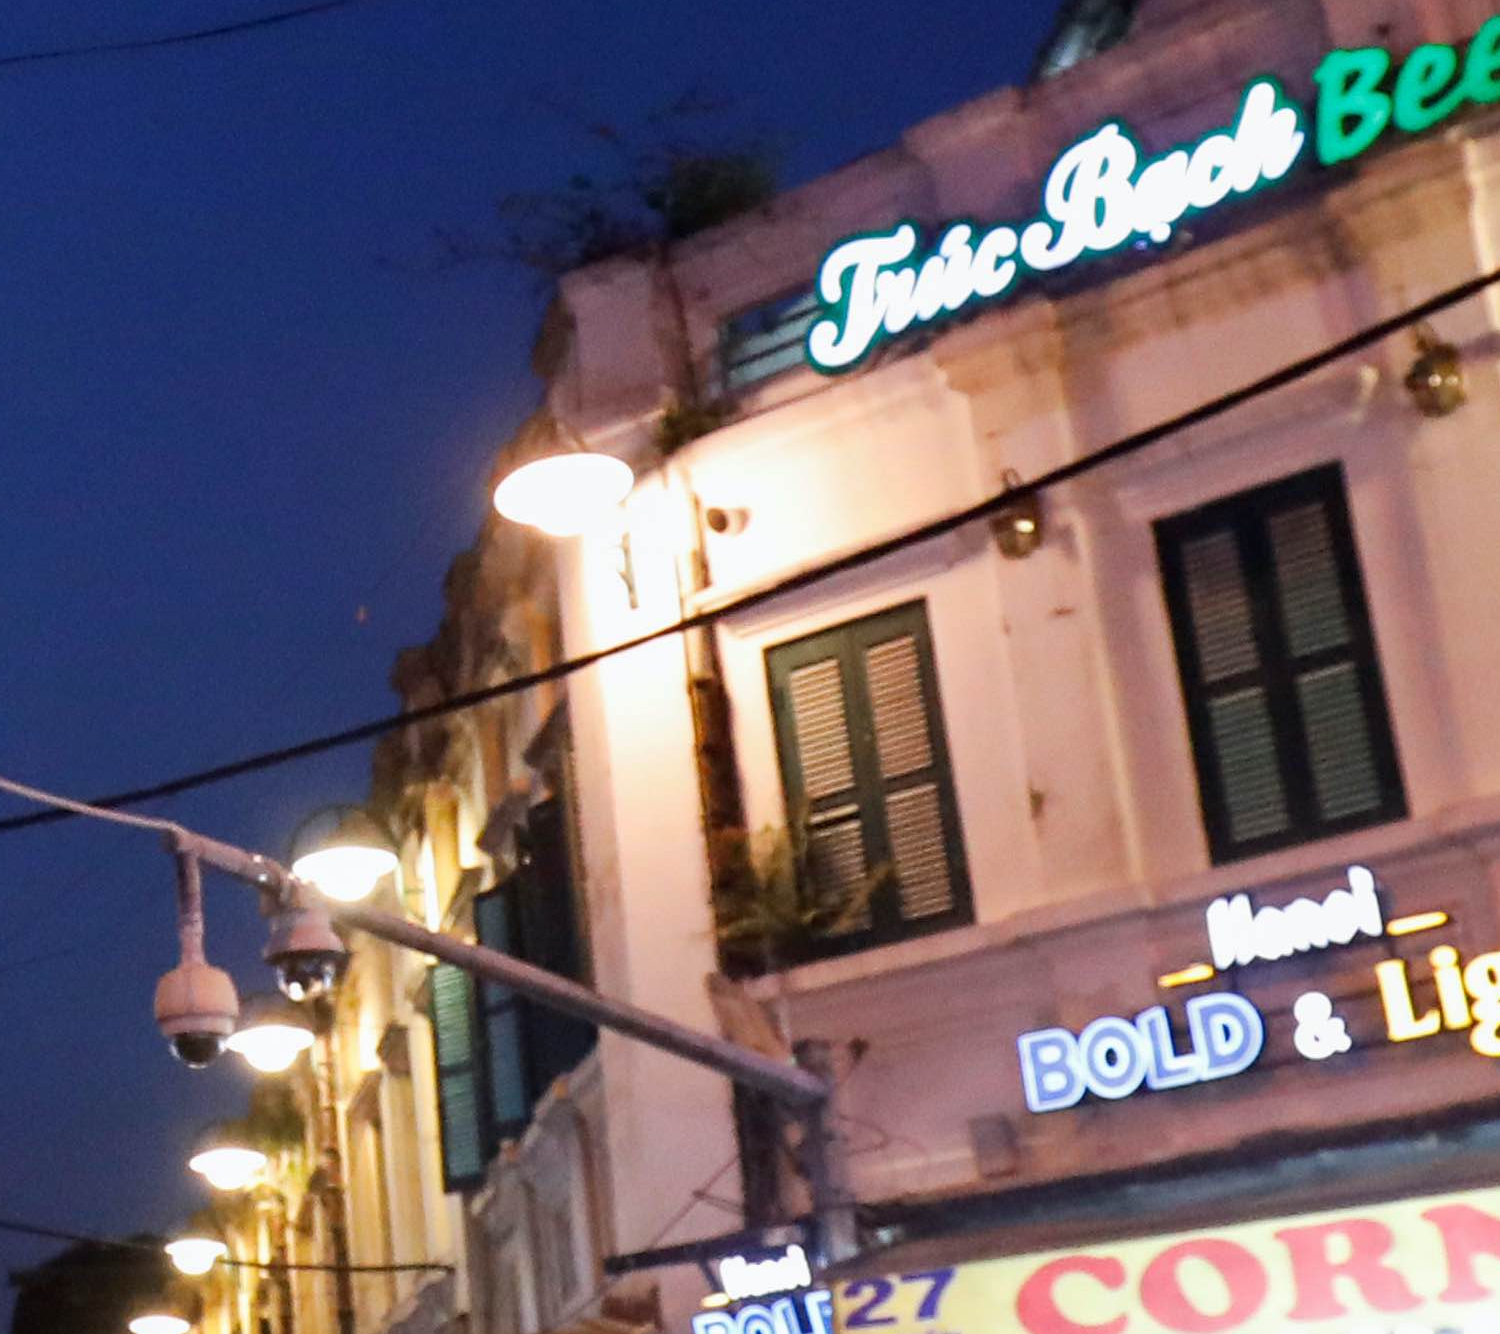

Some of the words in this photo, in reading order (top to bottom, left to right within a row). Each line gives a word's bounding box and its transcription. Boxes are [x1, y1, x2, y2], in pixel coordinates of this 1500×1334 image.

[1017, 992, 1264, 1114] BOLD
[1292, 991, 1353, 1061] &
[842, 1267, 956, 1330] 27
